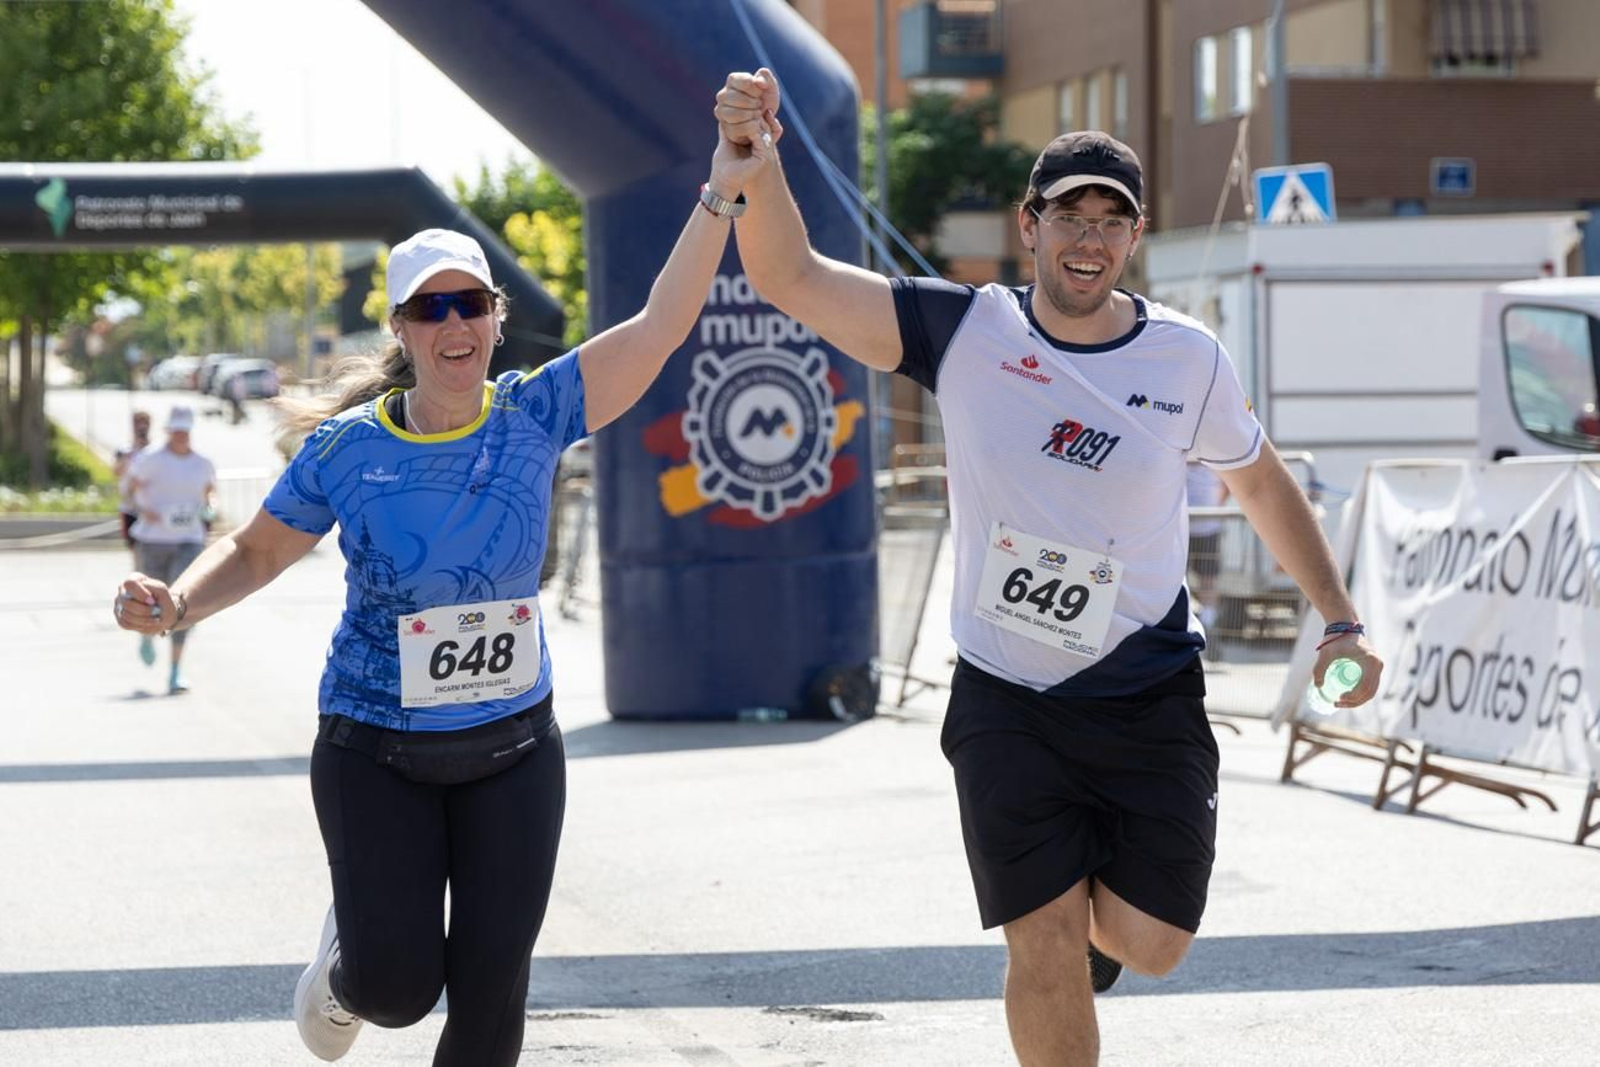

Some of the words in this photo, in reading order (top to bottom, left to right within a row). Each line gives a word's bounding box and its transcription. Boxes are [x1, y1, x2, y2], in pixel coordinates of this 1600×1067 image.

[1000, 361, 1053, 385] Santander
[1153, 400, 1184, 415] mupol
[1002, 567, 1090, 623] 649
[1058, 625, 1082, 640] MONTES
[428, 632, 516, 681] 648
